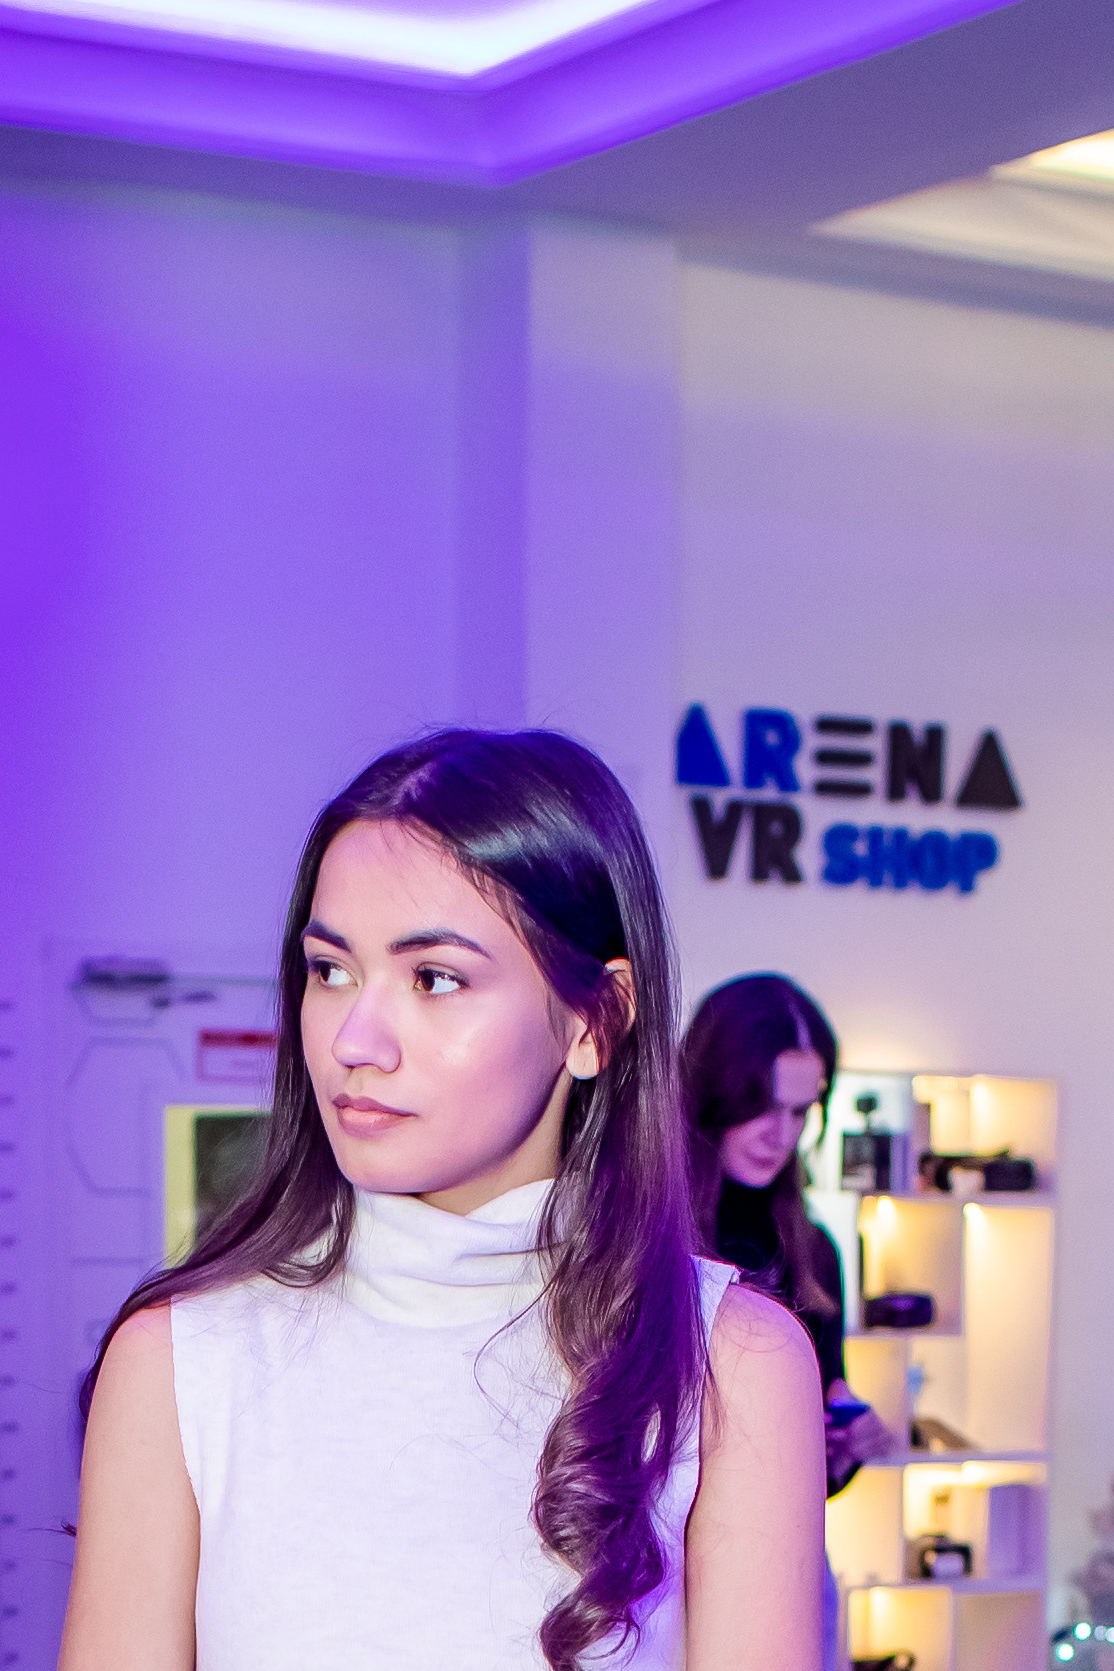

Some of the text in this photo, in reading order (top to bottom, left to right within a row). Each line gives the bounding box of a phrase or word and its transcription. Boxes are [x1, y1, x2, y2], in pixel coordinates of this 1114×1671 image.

[676, 703, 1023, 812] ARENA
[691, 794, 1001, 894] VR SHOP
